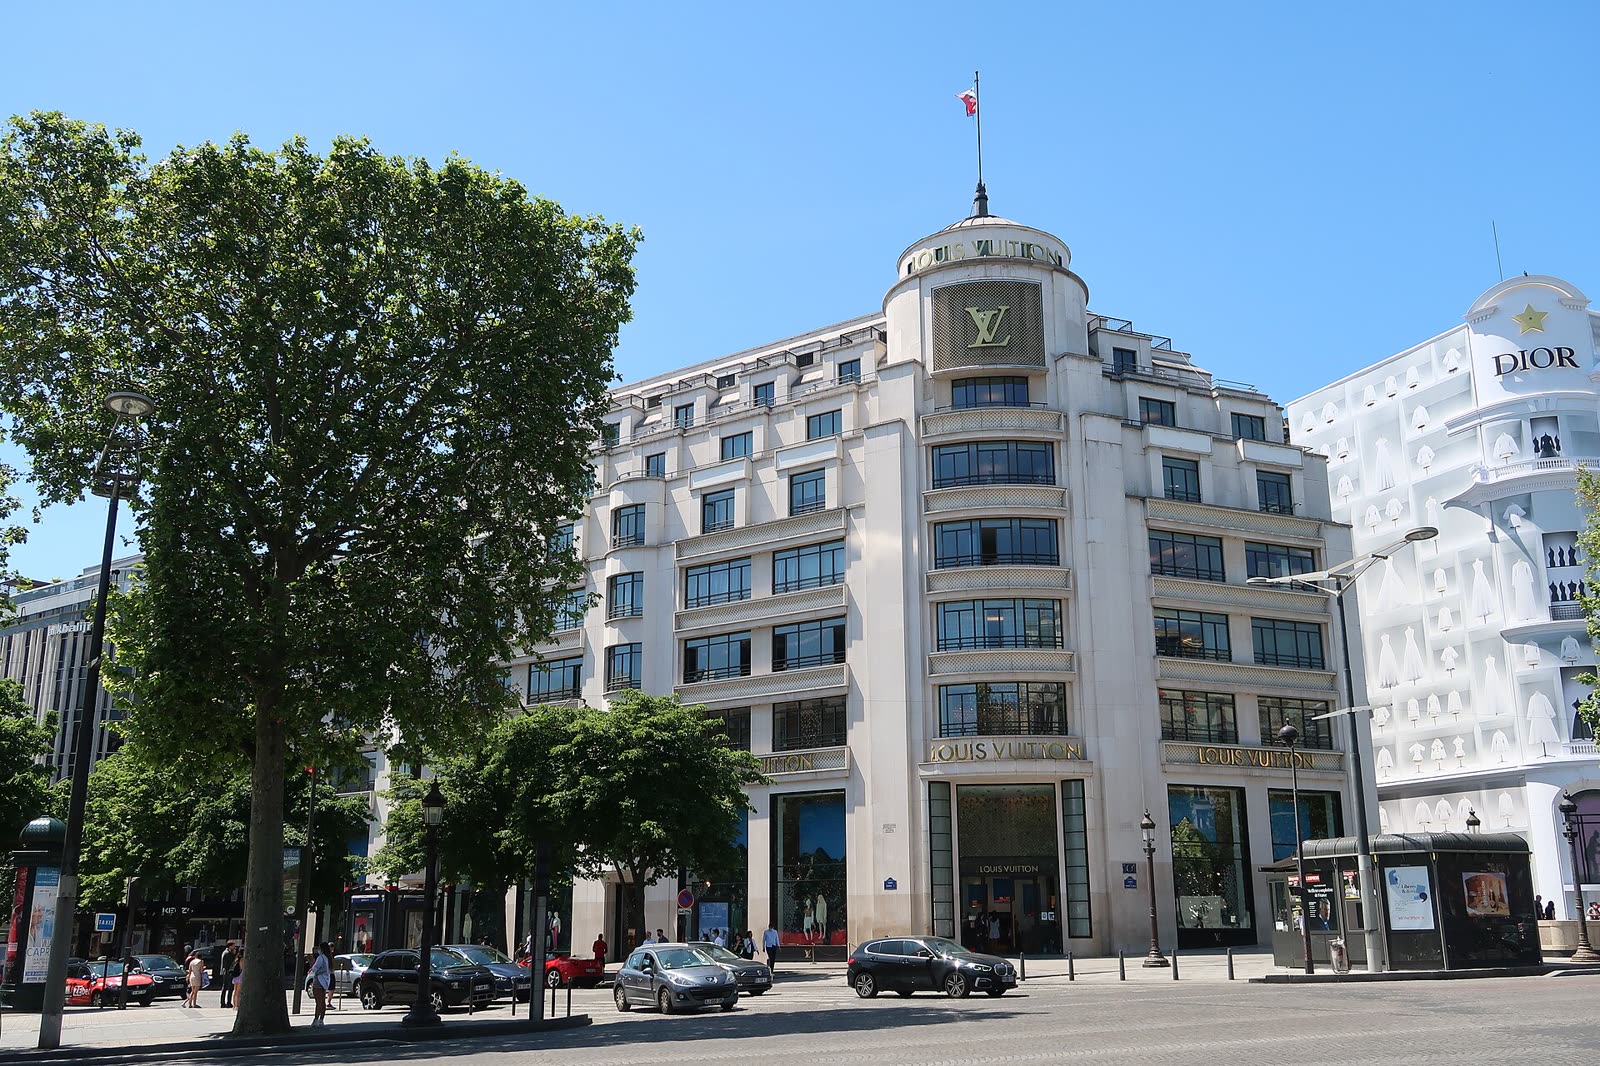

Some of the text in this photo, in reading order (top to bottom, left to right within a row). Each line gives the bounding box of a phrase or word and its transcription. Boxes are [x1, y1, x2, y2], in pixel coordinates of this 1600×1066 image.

[911, 239, 1060, 272] LOUIS VUITTON
[1491, 346, 1580, 377] DIOR
[931, 742, 1081, 762] LOUIS VUITTON
[1198, 748, 1316, 769] LOUIS VUITTON
[980, 865, 1039, 873] LOUIS VUITTON
